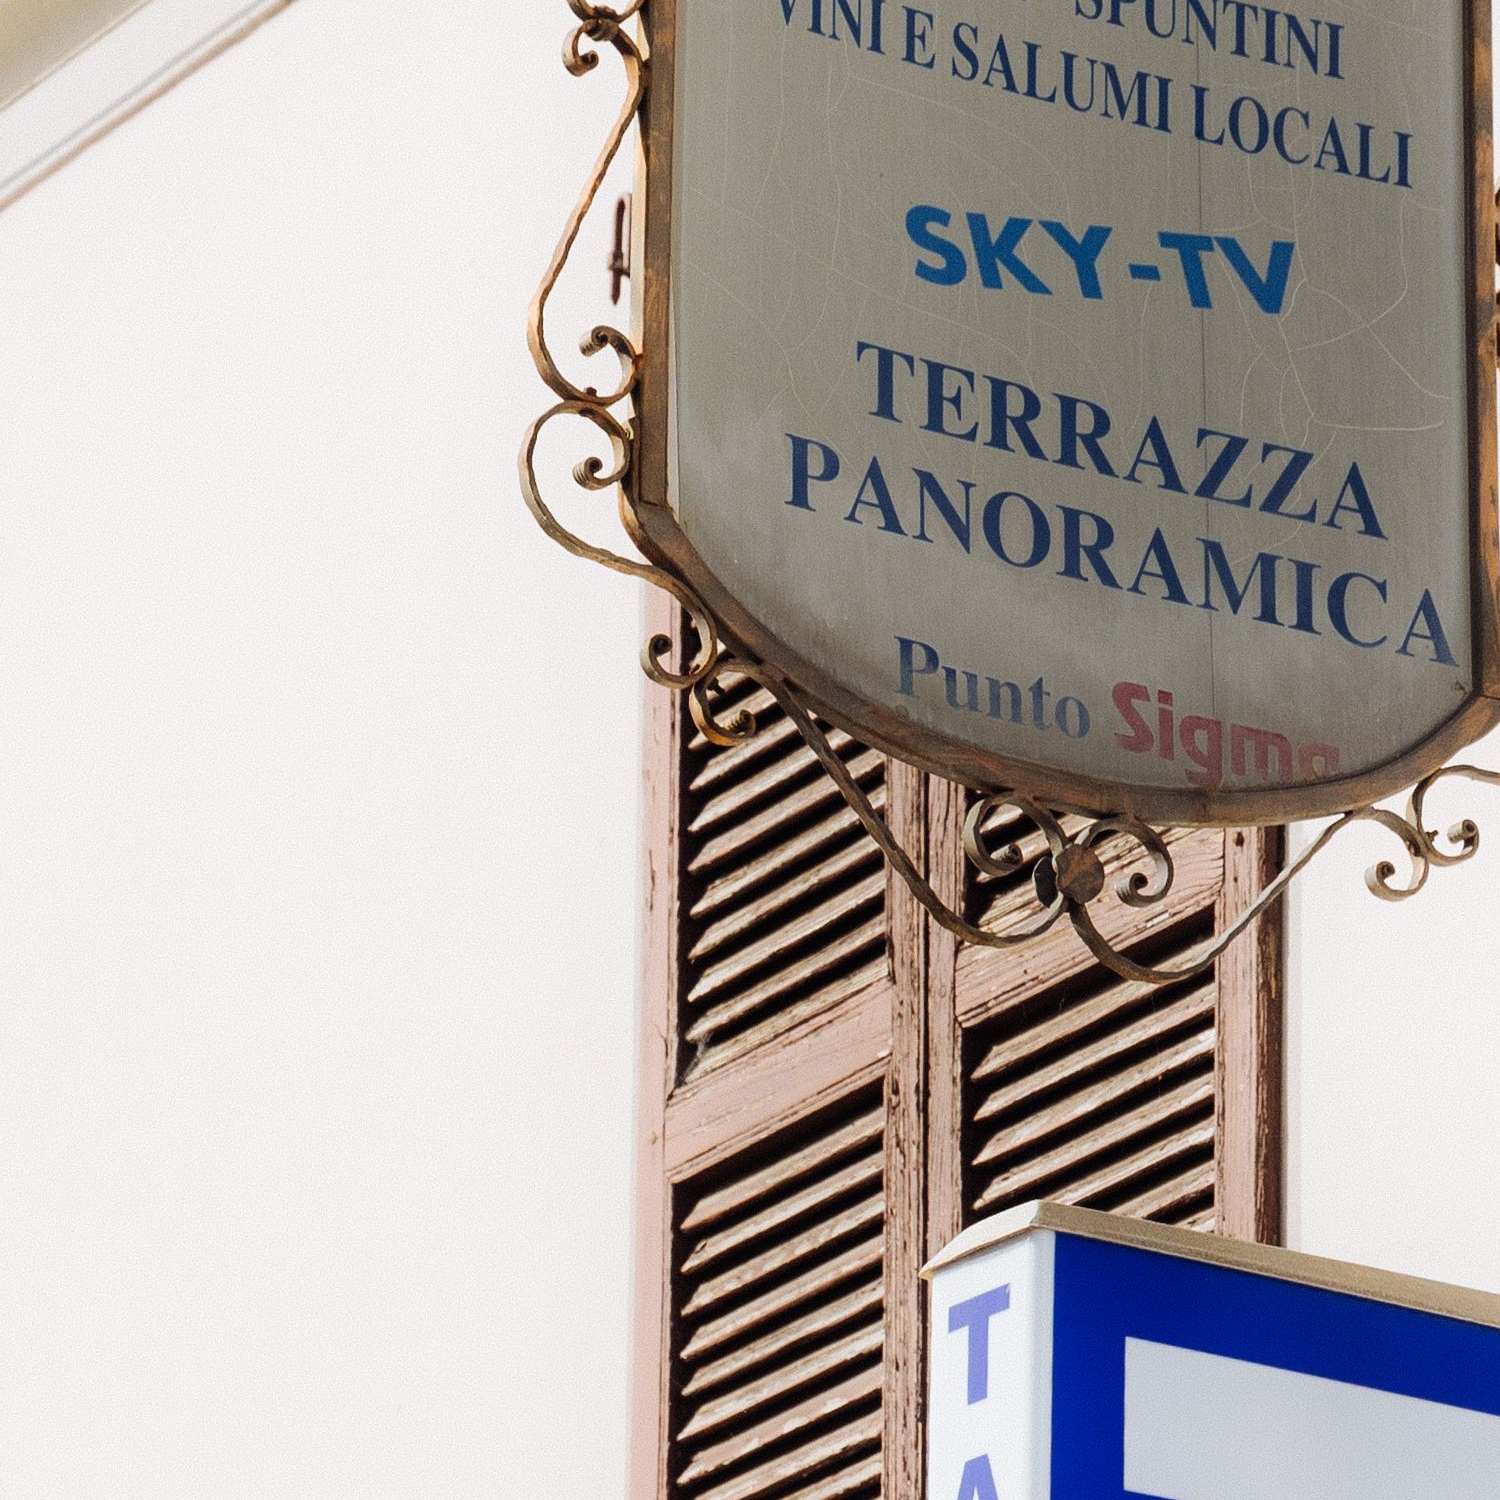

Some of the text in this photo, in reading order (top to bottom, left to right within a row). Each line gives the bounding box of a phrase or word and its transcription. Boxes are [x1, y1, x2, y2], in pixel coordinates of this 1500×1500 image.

[902, 6, 937, 69] E
[951, 22, 1172, 134] SALUMI
[1192, 83, 1413, 189] LOCALI
[904, 204, 1296, 316] SKY-TV
[856, 340, 1389, 542] TERRAZZA
[784, 432, 1459, 668] PANORAMICA
[893, 635, 1092, 740] Punto
